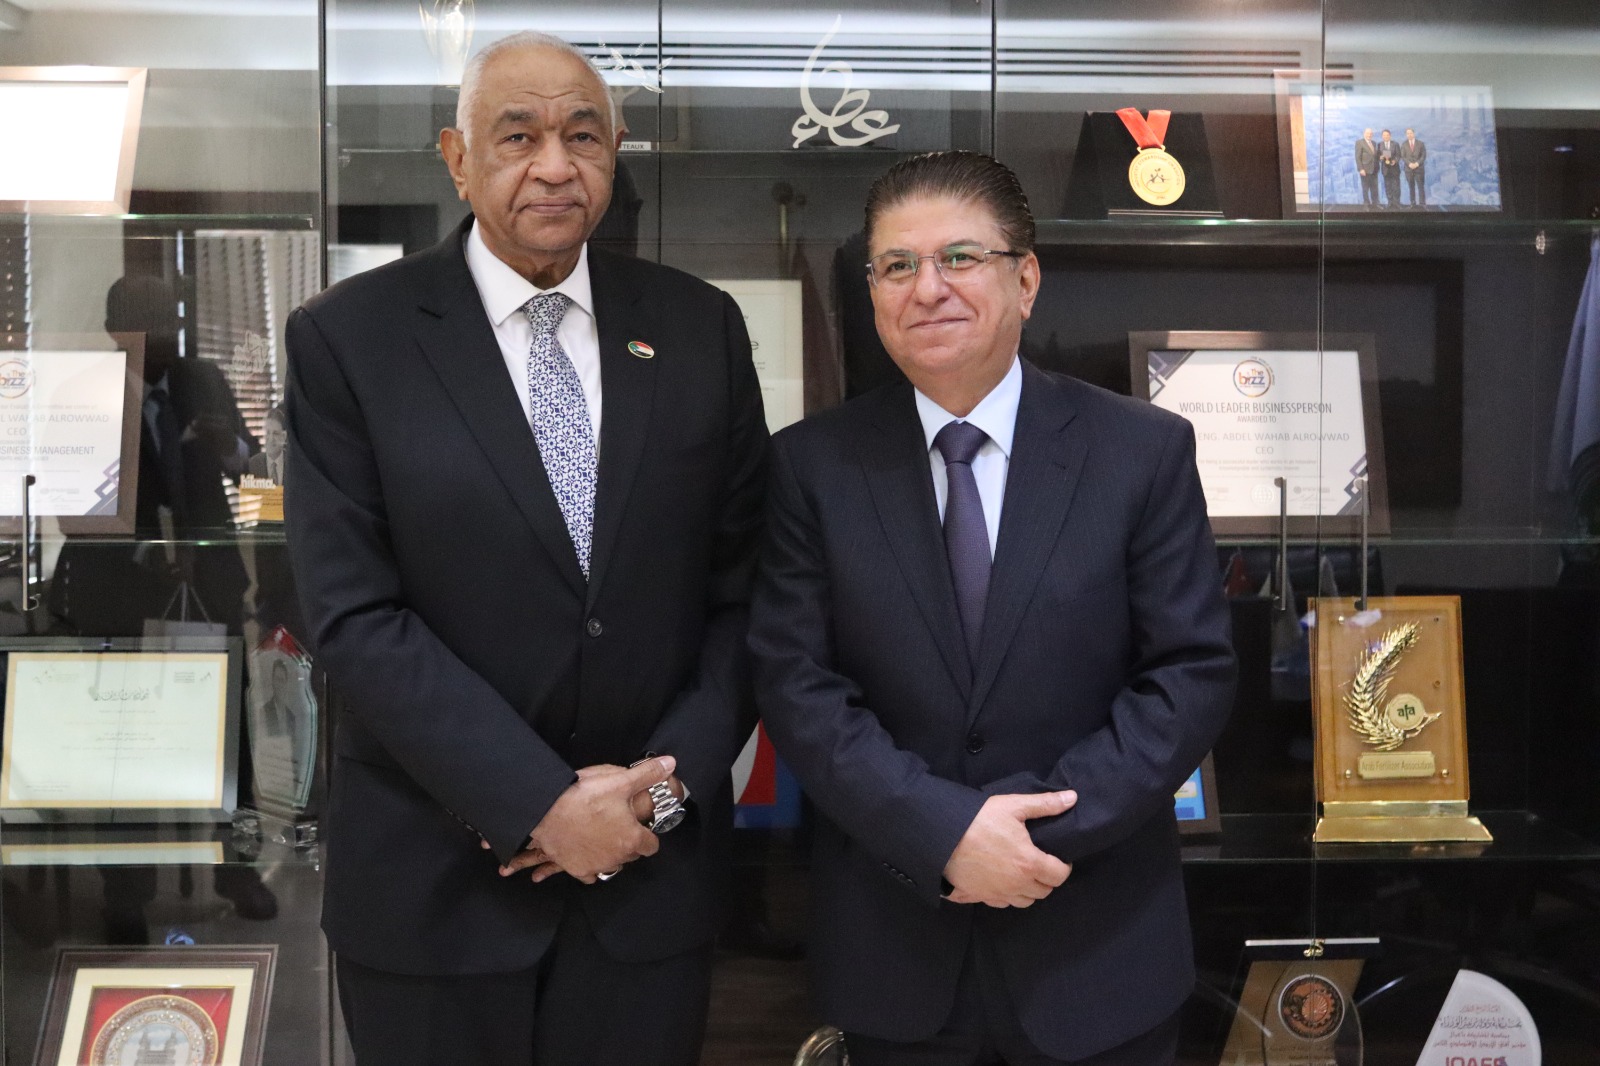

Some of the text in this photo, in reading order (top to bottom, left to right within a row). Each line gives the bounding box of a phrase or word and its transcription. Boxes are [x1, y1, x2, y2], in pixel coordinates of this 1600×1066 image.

[1179, 402, 1332, 414] WORLD LEADER BUSINESSPERSON
[48, 414, 109, 423] ALROWWAD
[1237, 415, 1277, 423] AWARDED TO
[7, 427, 27, 436] CEO
[1223, 432, 1252, 441] ABDEL
[1254, 432, 1290, 441] WAHAB
[0, 446, 95, 455] SINESS MANAGEMENT
[1255, 446, 1274, 455] CEO
[1397, 704, 1416, 720] afa
